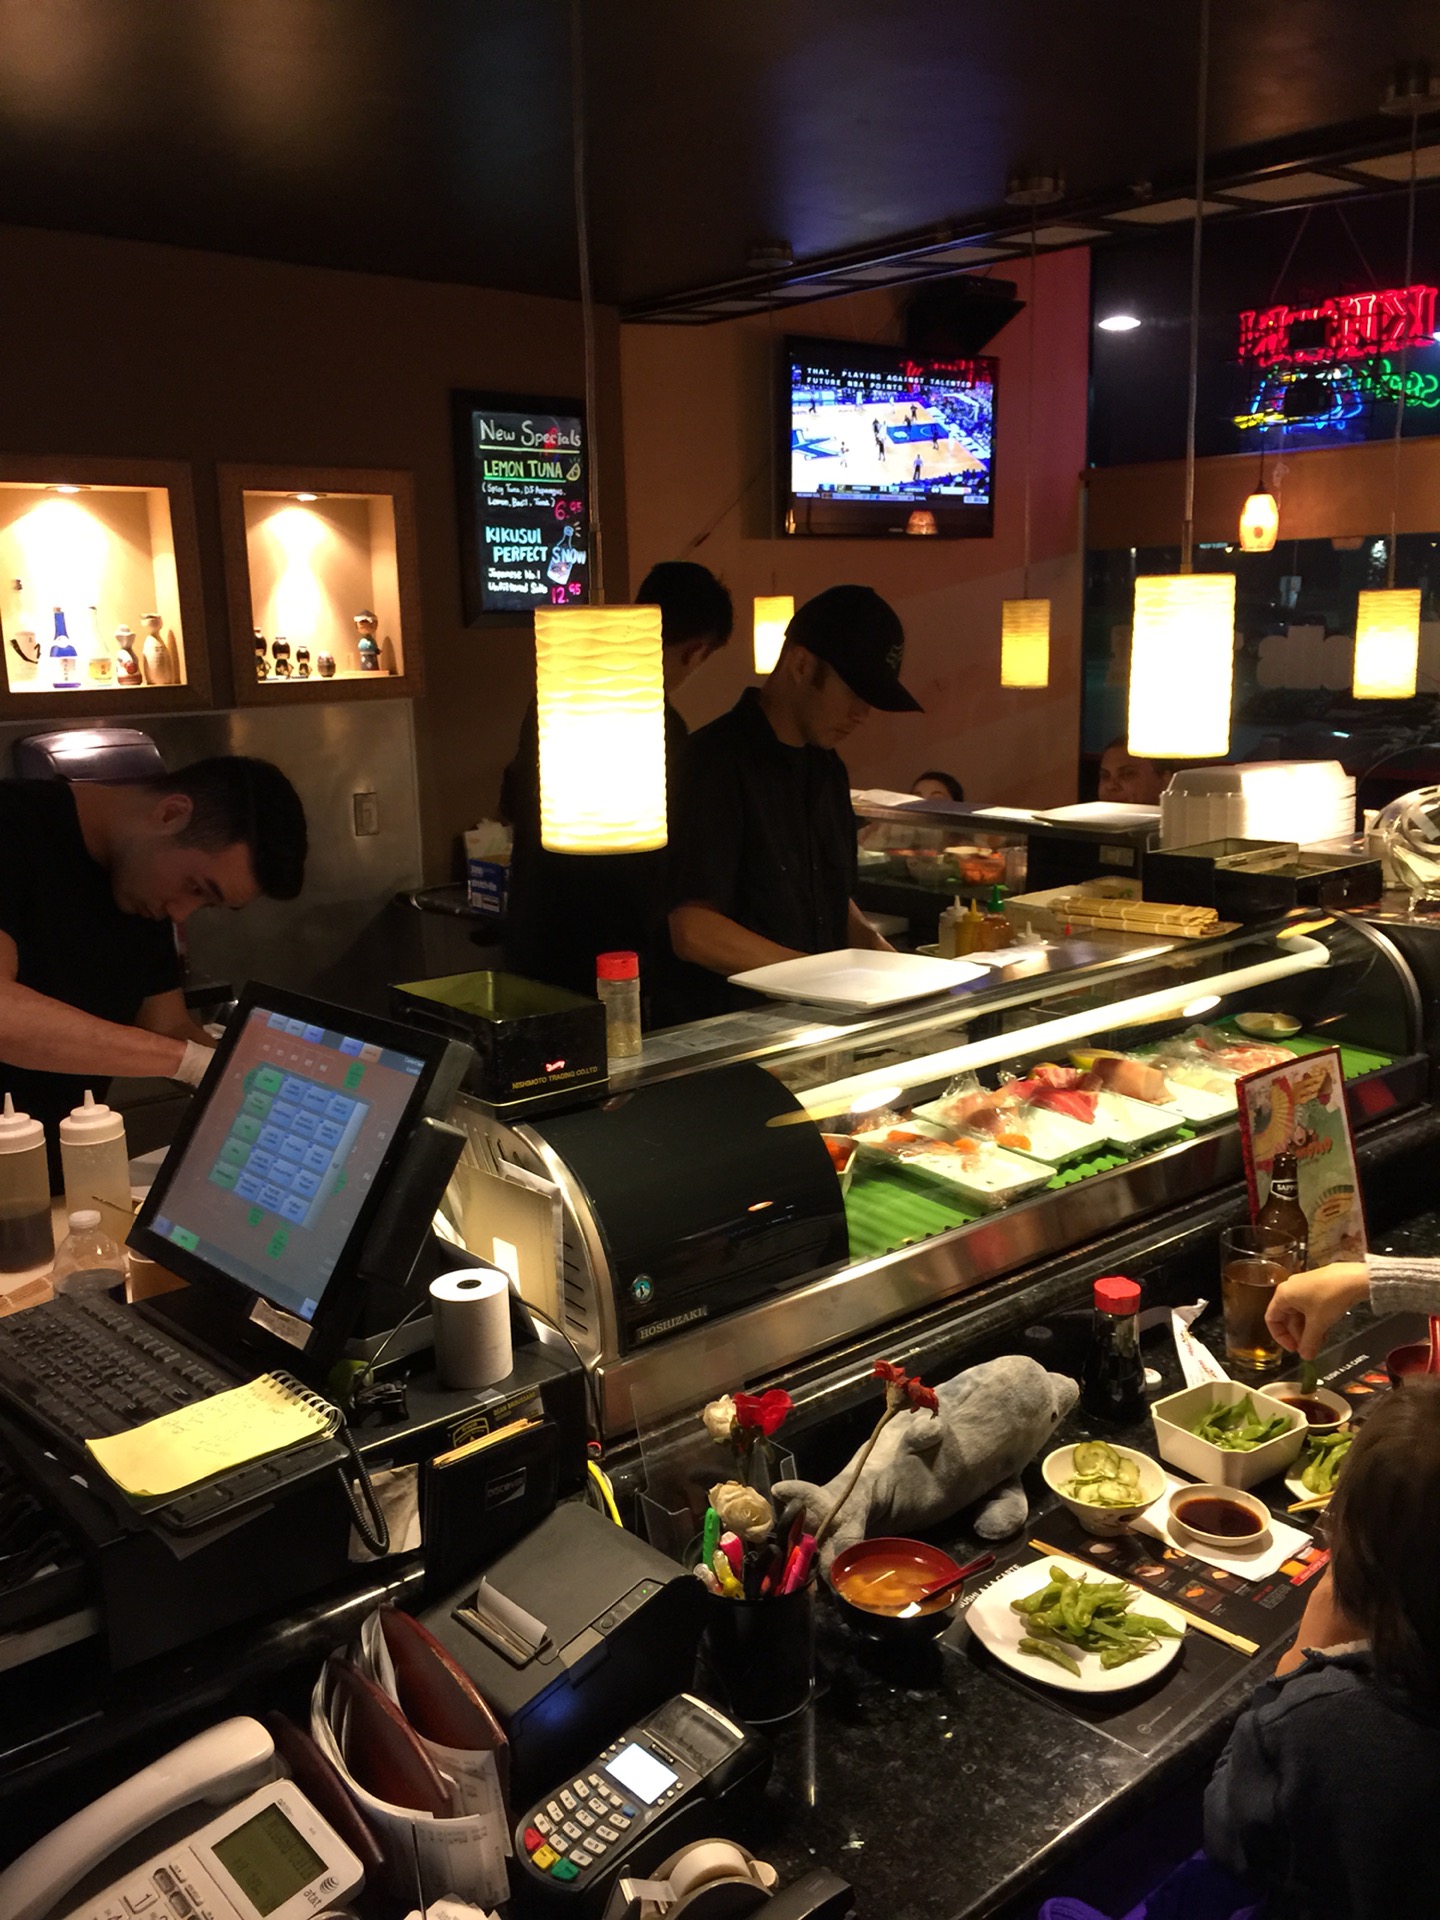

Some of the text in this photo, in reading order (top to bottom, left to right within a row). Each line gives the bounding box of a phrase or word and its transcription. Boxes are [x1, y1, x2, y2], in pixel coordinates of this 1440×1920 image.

[807, 377, 841, 387] FUTURE
[842, 370, 881, 381] PLAYING
[886, 374, 924, 385] AGAINST
[930, 378, 972, 388] TALENTED
[480, 419, 581, 446] New Specials
[484, 460, 563, 478] LEMON TUNA
[485, 526, 542, 544] KIKUSUI
[492, 546, 586, 565] PERFECT SNOW
[512, 1077, 547, 1089] NISHIMOTO
[548, 1070, 575, 1082] TRADING
[640, 1307, 704, 1339] HOSHIZAKI
[303, 1889, 322, 1908] at&t
